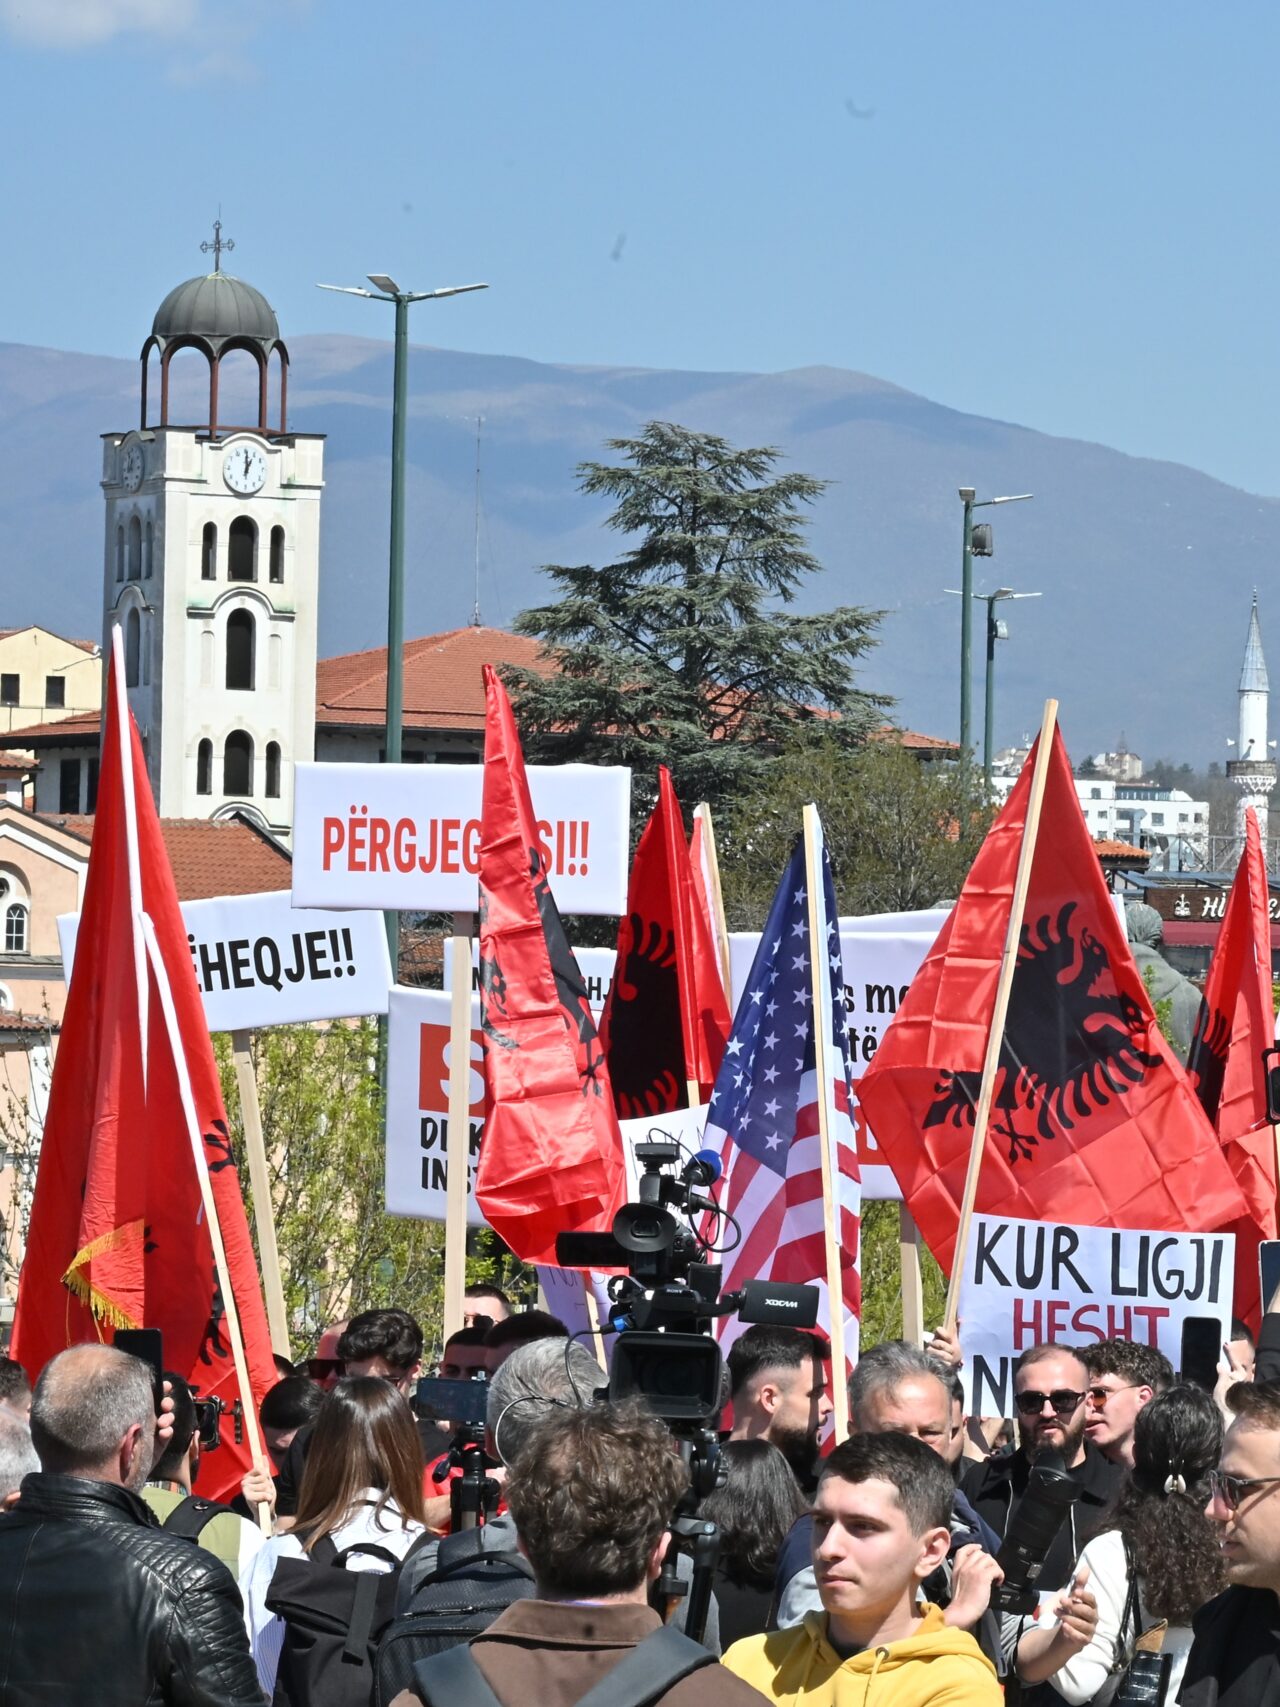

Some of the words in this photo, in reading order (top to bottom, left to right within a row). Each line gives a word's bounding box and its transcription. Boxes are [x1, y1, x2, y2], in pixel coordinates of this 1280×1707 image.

[322, 804, 590, 876] PËRGJEGSI!!
[974, 1222, 1094, 1294] KUR
[1111, 1232, 1224, 1303] LIGJI
